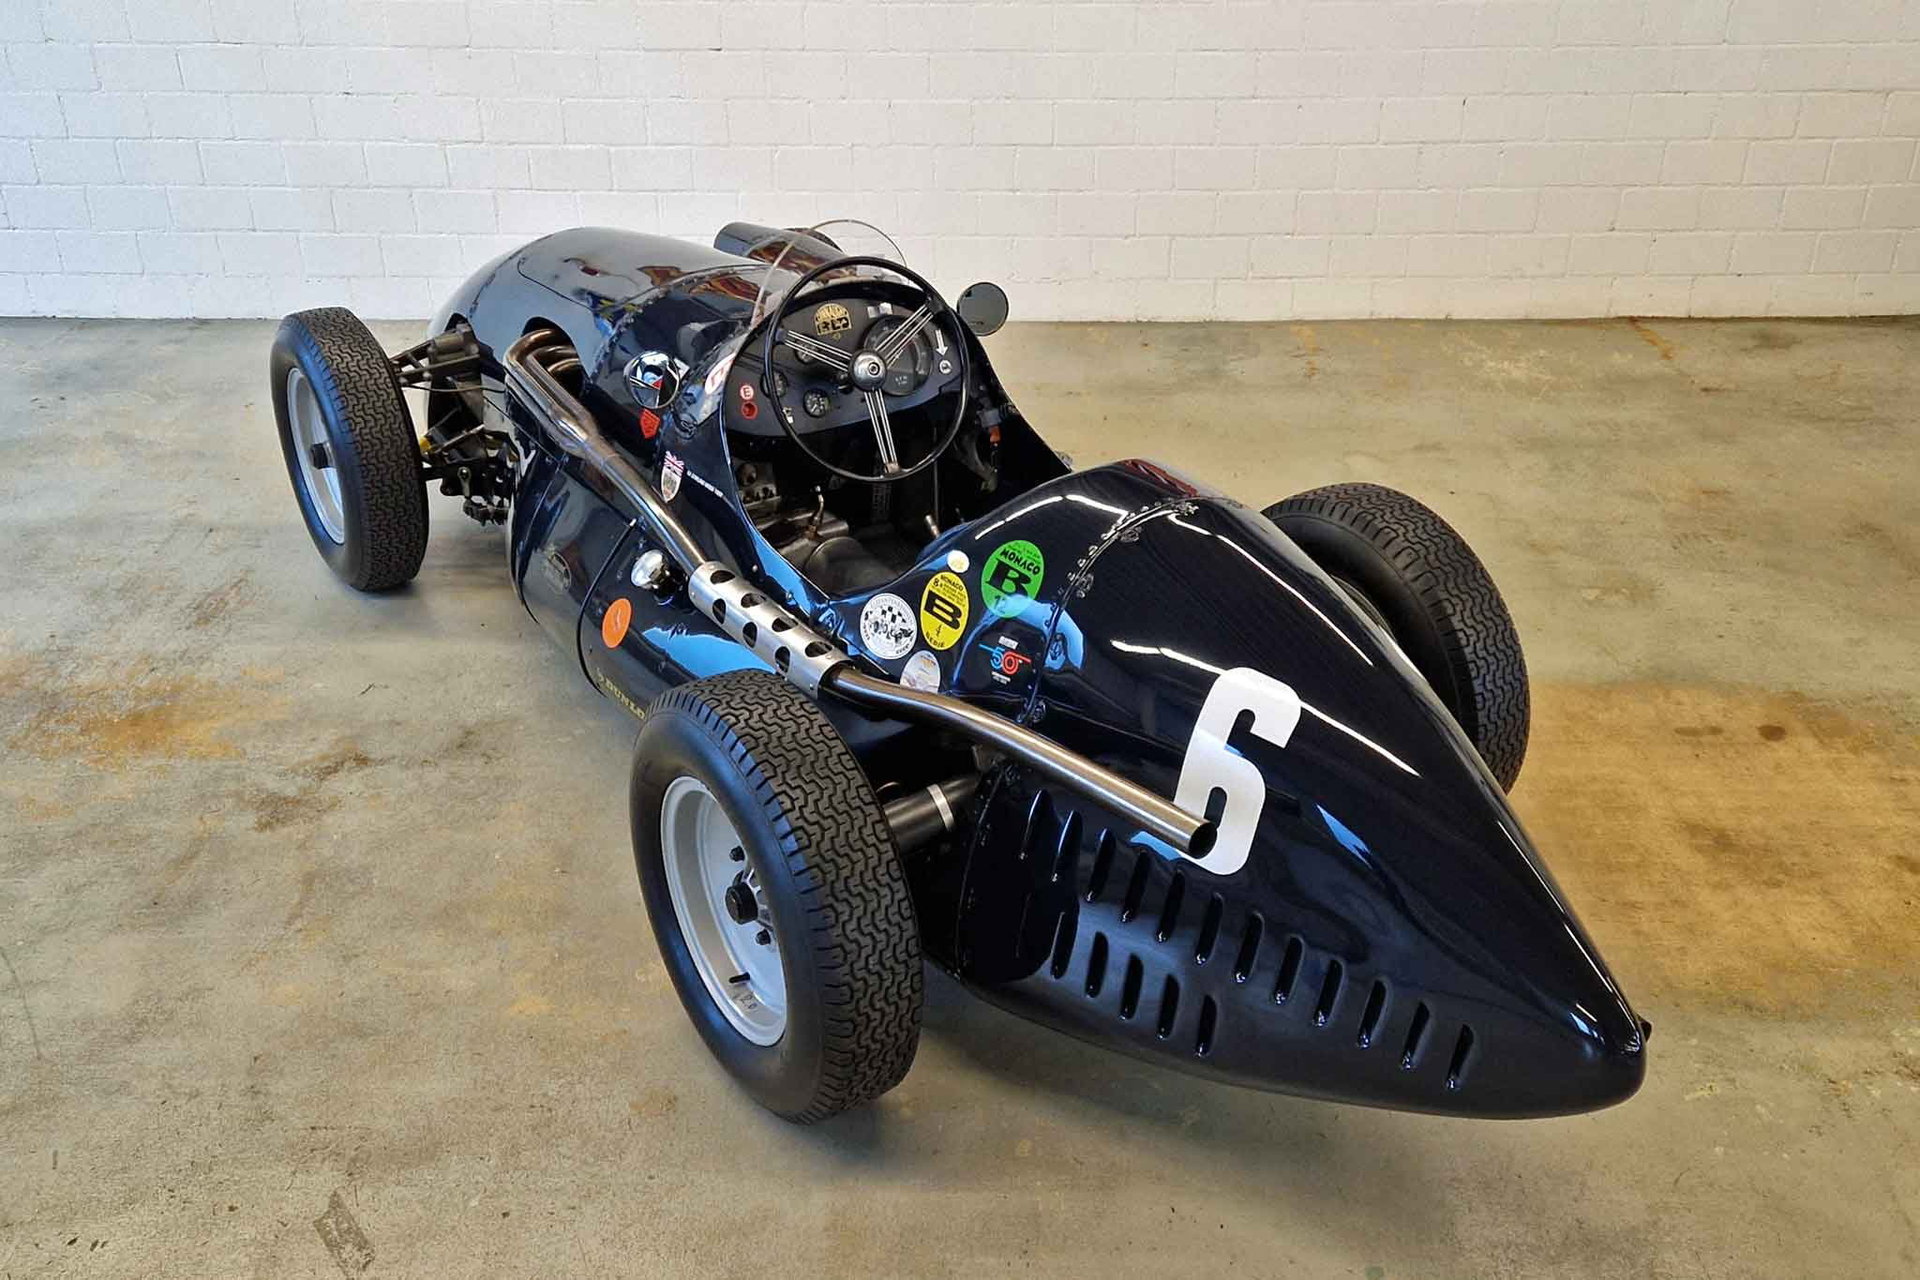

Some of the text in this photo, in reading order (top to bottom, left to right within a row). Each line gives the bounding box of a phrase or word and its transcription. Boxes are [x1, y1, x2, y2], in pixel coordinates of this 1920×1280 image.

[1000, 549, 1041, 575] MONACO
[940, 575, 964, 592] MONACO
[923, 589, 963, 630] B
[1173, 667, 1302, 876] 6
